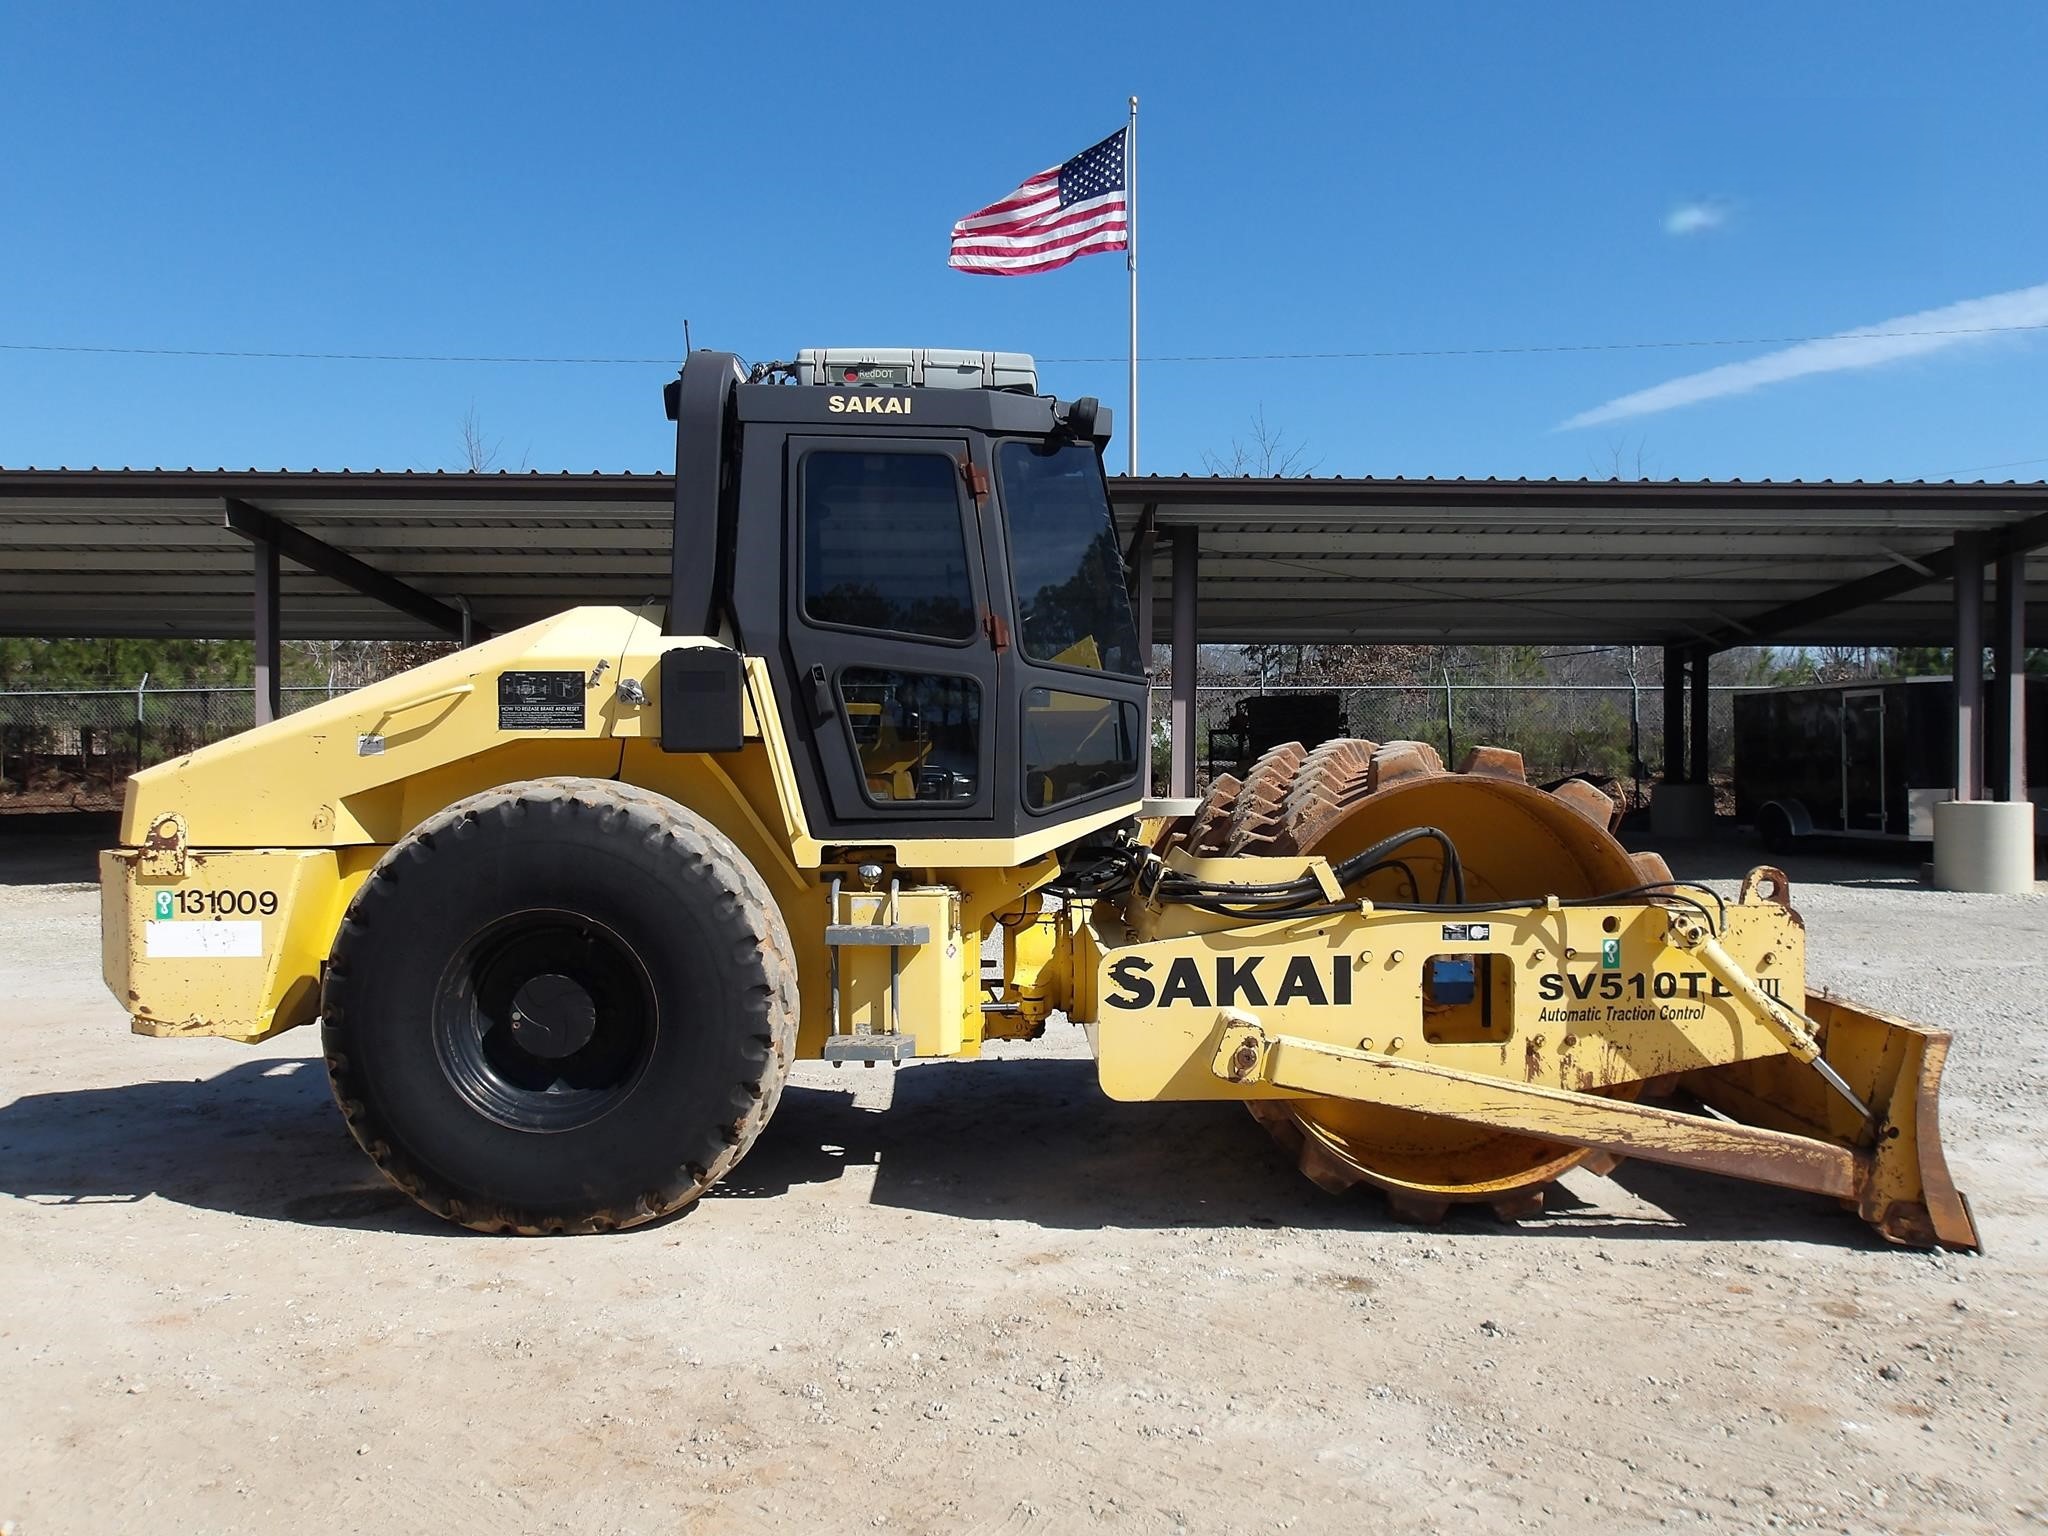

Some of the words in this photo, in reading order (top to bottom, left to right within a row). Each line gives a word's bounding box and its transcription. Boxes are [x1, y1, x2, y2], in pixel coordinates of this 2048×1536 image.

[859, 369, 894, 379] RedDOT
[828, 395, 912, 414] SAKAI
[174, 889, 279, 915] 131009
[1104, 955, 1352, 1010] SAKAI
[1538, 1006, 1602, 1022] Automatic
[1604, 1005, 1658, 1021] Traction
[1659, 1005, 1706, 1021] Control
